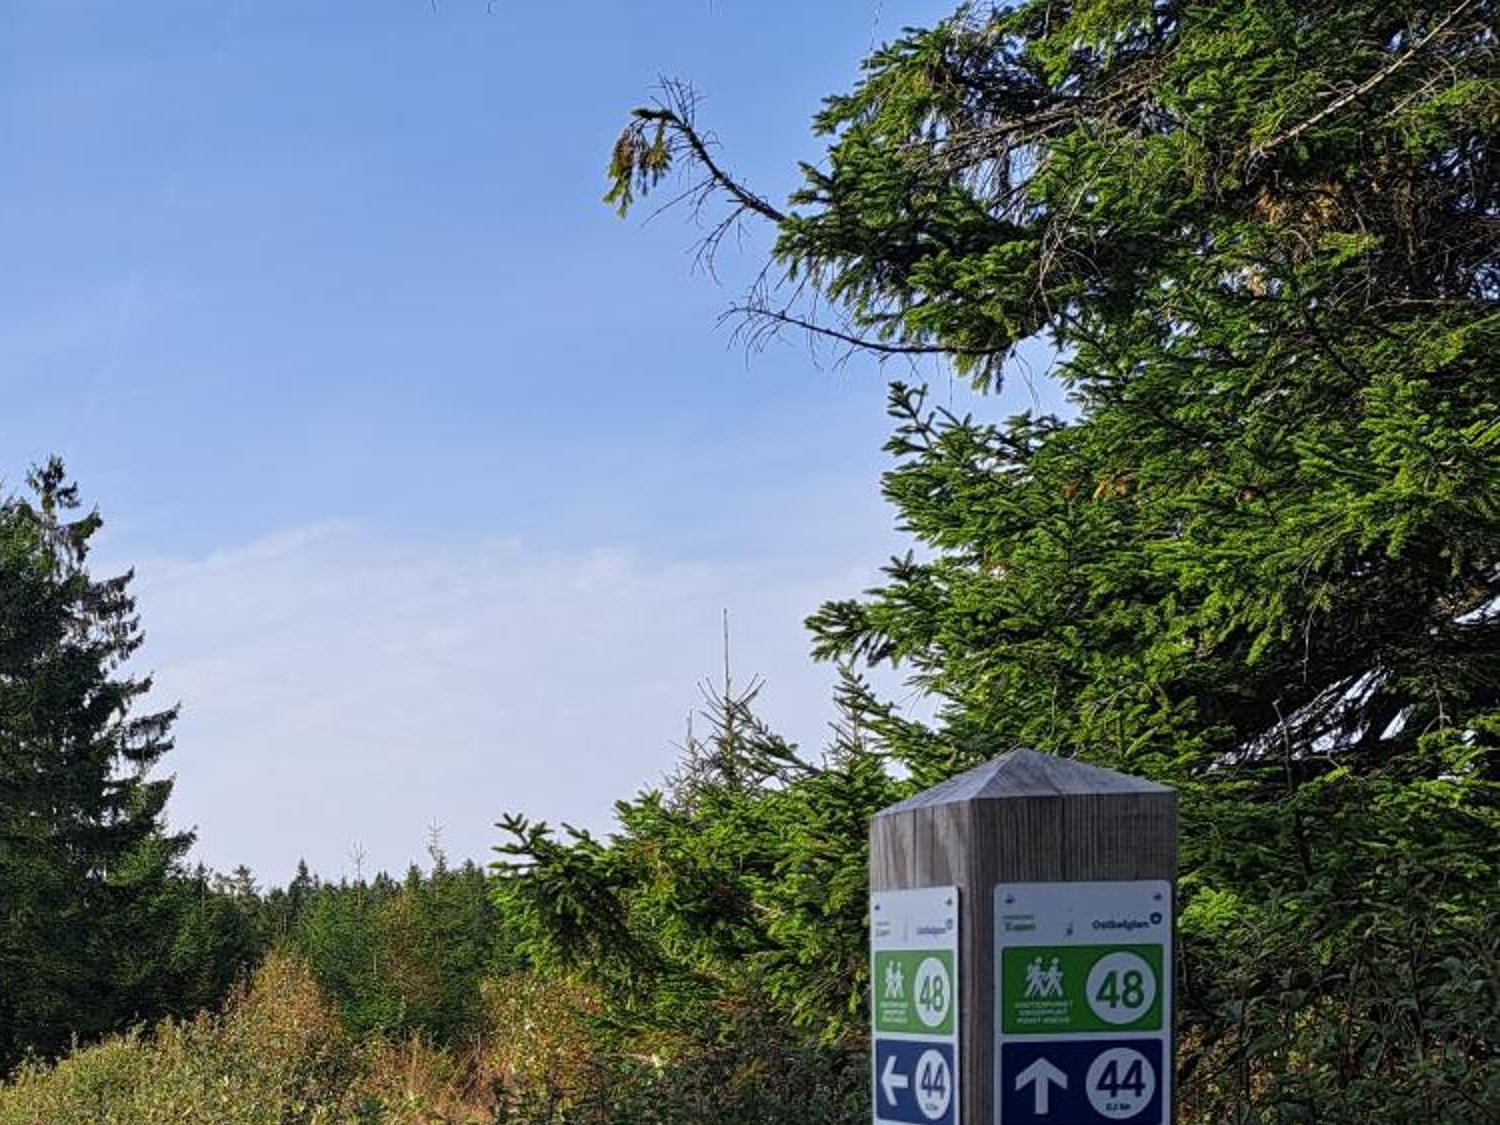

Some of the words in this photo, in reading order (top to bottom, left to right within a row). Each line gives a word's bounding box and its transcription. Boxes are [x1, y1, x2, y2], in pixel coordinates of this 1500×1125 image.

[919, 975, 945, 1012] 48
[1095, 969, 1145, 1009] 48
[921, 1061, 946, 1100] 44
[1095, 1059, 1146, 1098] 44
